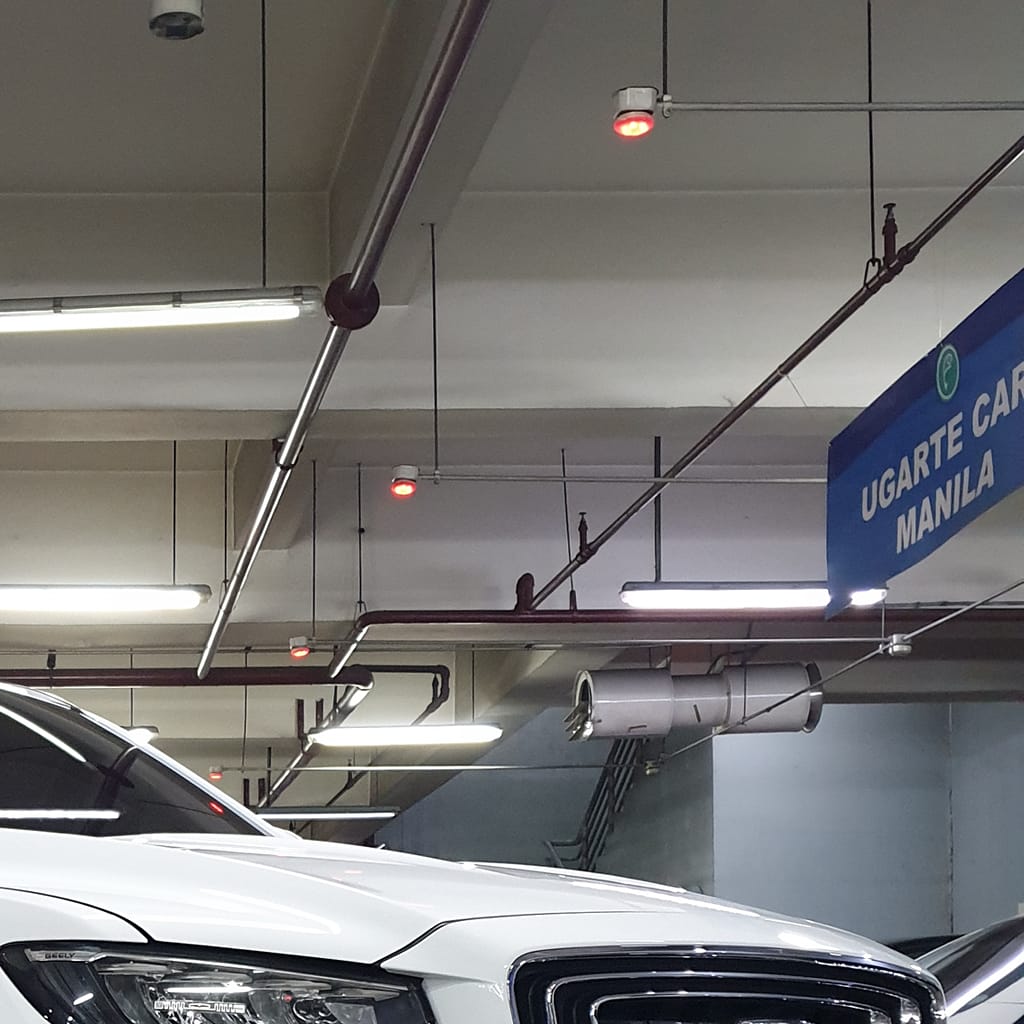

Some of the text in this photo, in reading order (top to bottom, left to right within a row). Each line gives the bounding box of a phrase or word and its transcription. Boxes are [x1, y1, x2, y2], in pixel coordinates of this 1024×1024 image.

[861, 411, 963, 522] UGARTE
[896, 449, 995, 554] MANILA
[44, 951, 76, 960] GEELY
